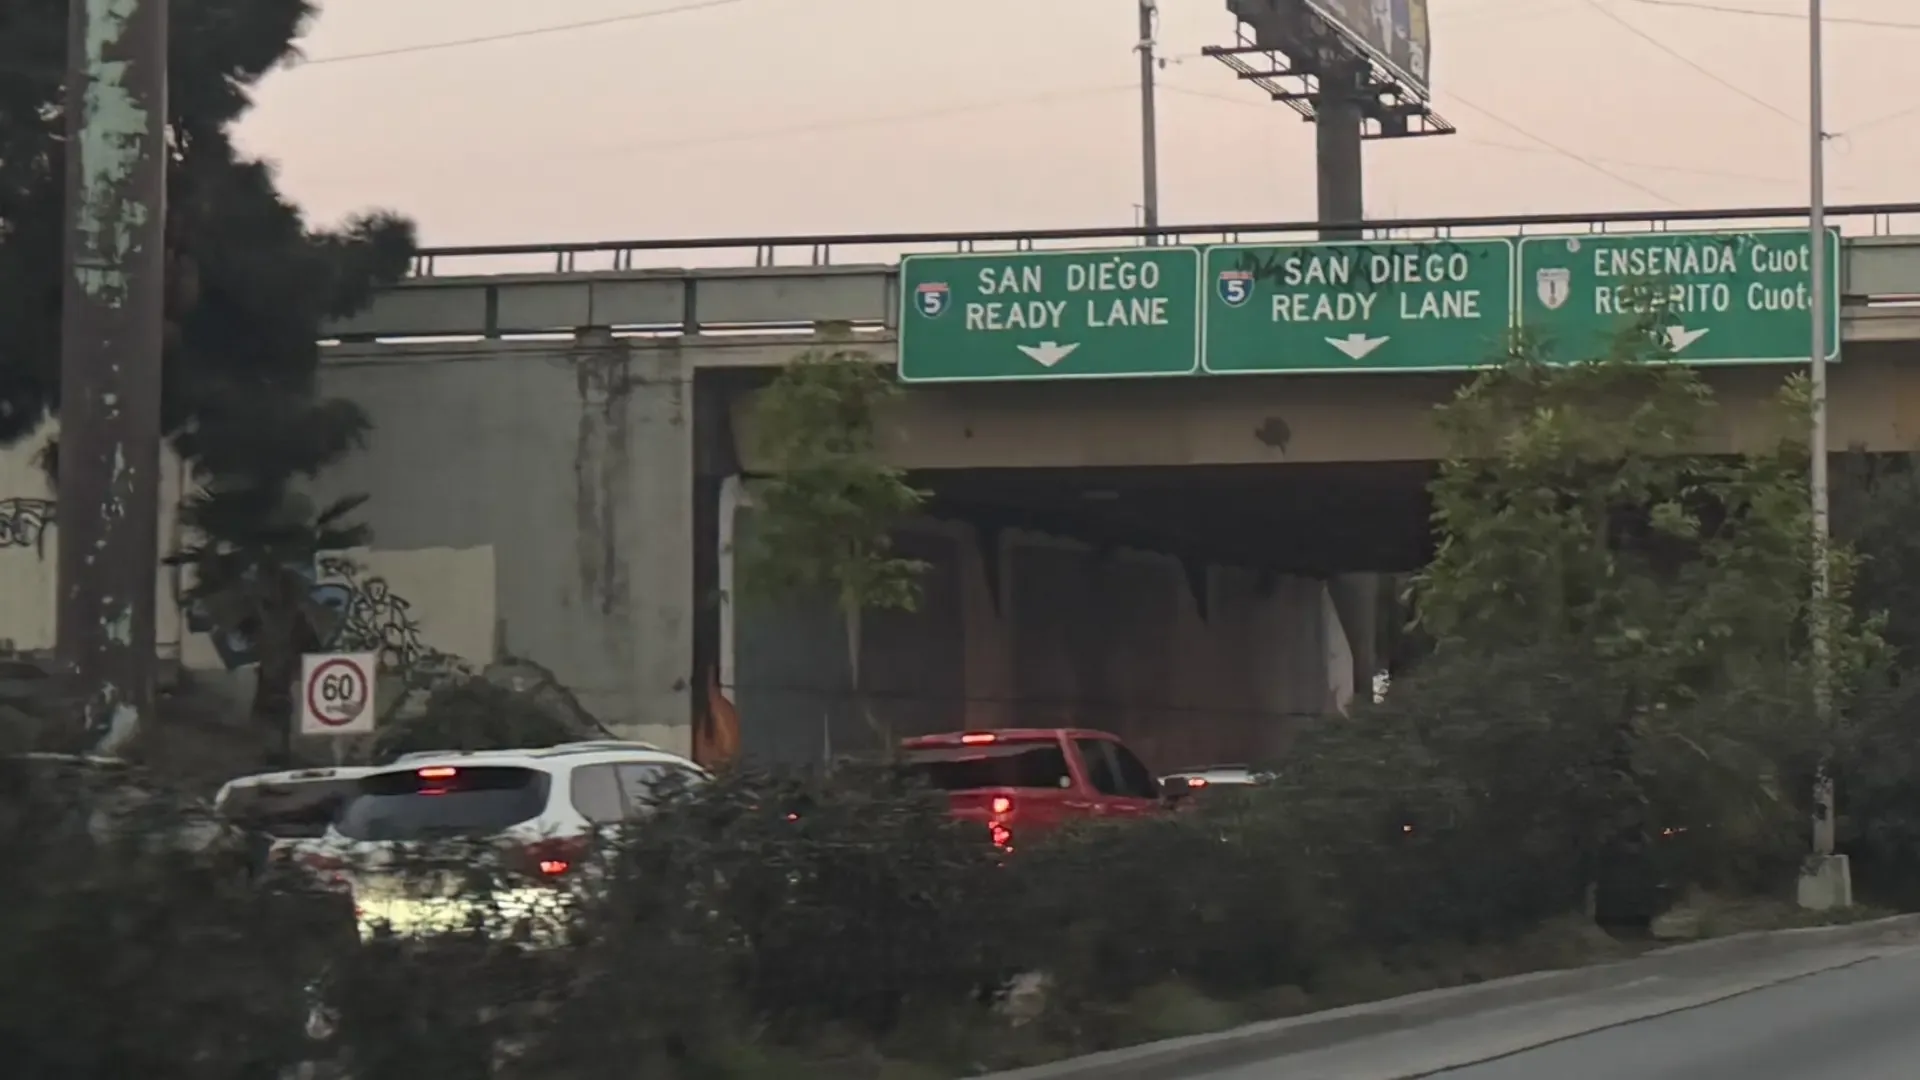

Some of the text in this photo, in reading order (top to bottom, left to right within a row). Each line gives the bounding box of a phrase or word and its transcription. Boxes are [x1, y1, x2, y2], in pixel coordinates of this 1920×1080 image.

[1284, 252, 1469, 286] SAN DIEGO
[1594, 243, 1810, 277] ENSENADA Cuot
[977, 260, 1160, 295] SAN DIEGO
[1227, 279, 1245, 302] 5
[923, 291, 941, 314] 5
[1271, 289, 1481, 322] READY LANE
[1747, 281, 1813, 311] Cuot
[966, 297, 1169, 330] READY LANE
[322, 673, 354, 701] 60
